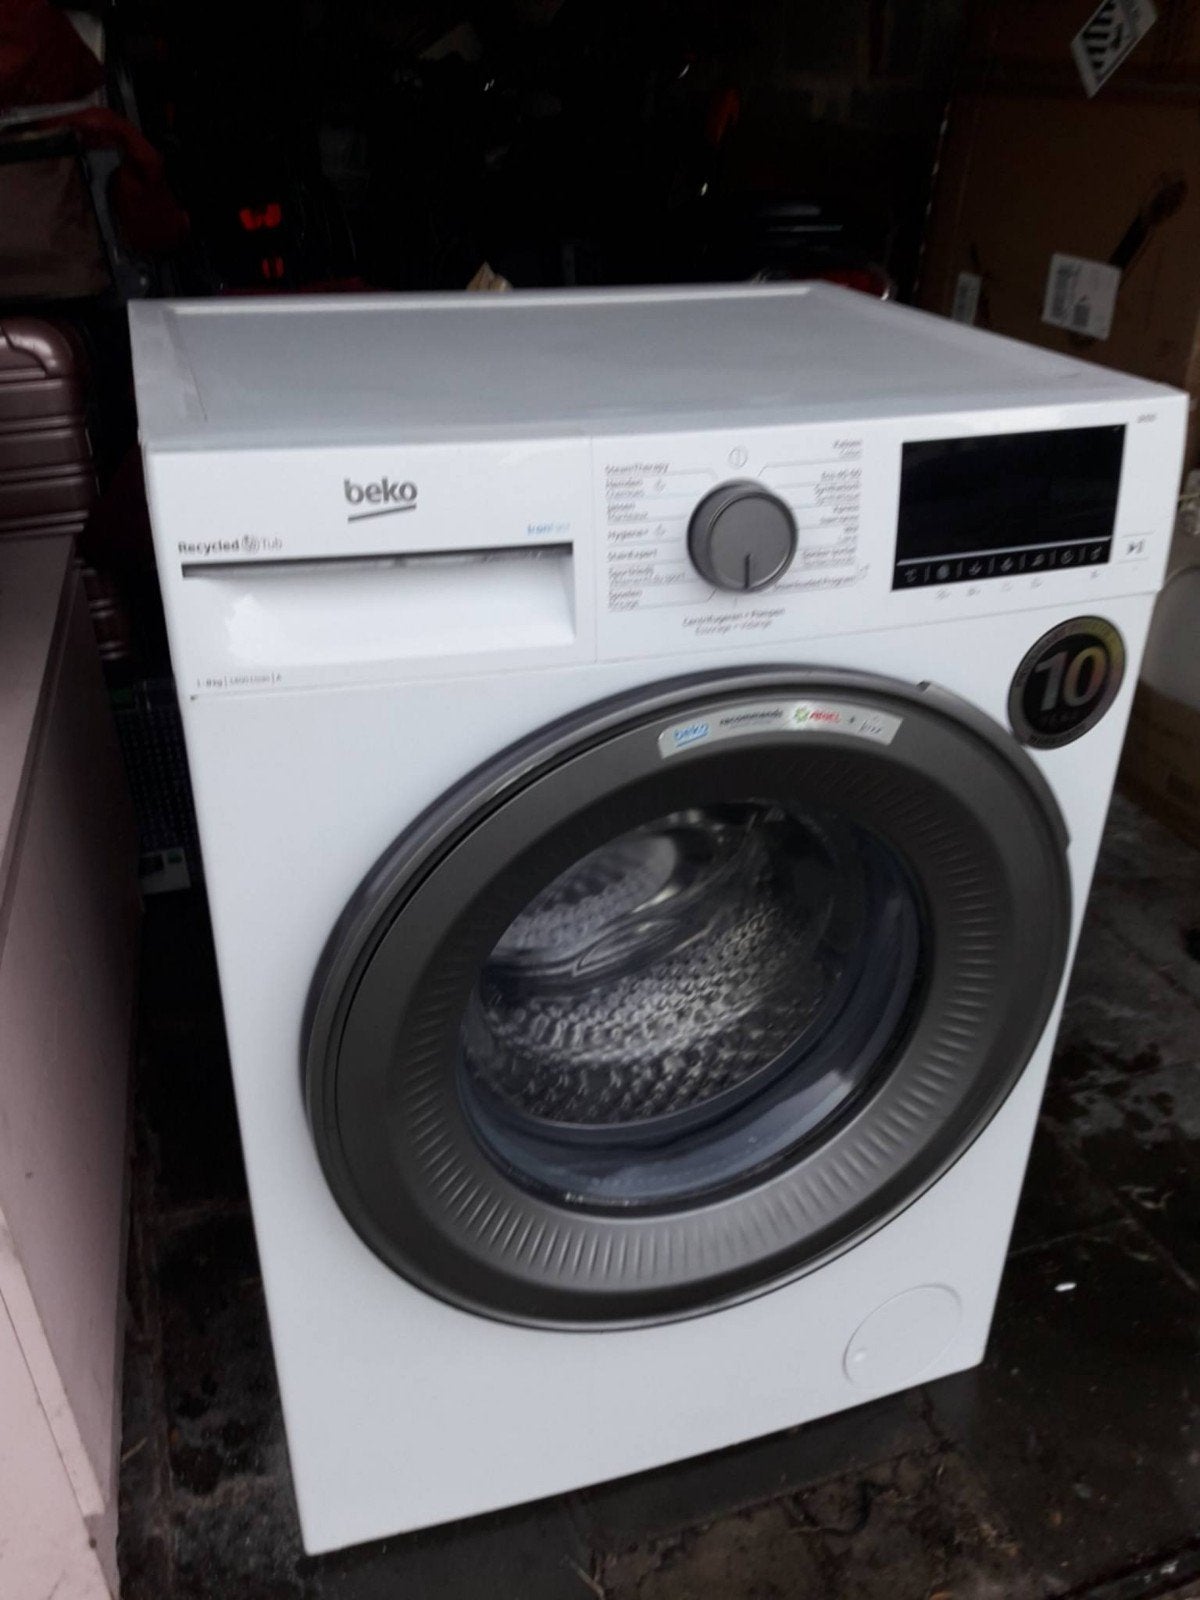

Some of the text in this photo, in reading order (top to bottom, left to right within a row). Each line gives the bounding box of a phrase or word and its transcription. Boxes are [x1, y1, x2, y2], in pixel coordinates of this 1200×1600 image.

[344, 477, 417, 506] beko
[178, 537, 240, 555] Recycled
[1035, 646, 1106, 711] 10
